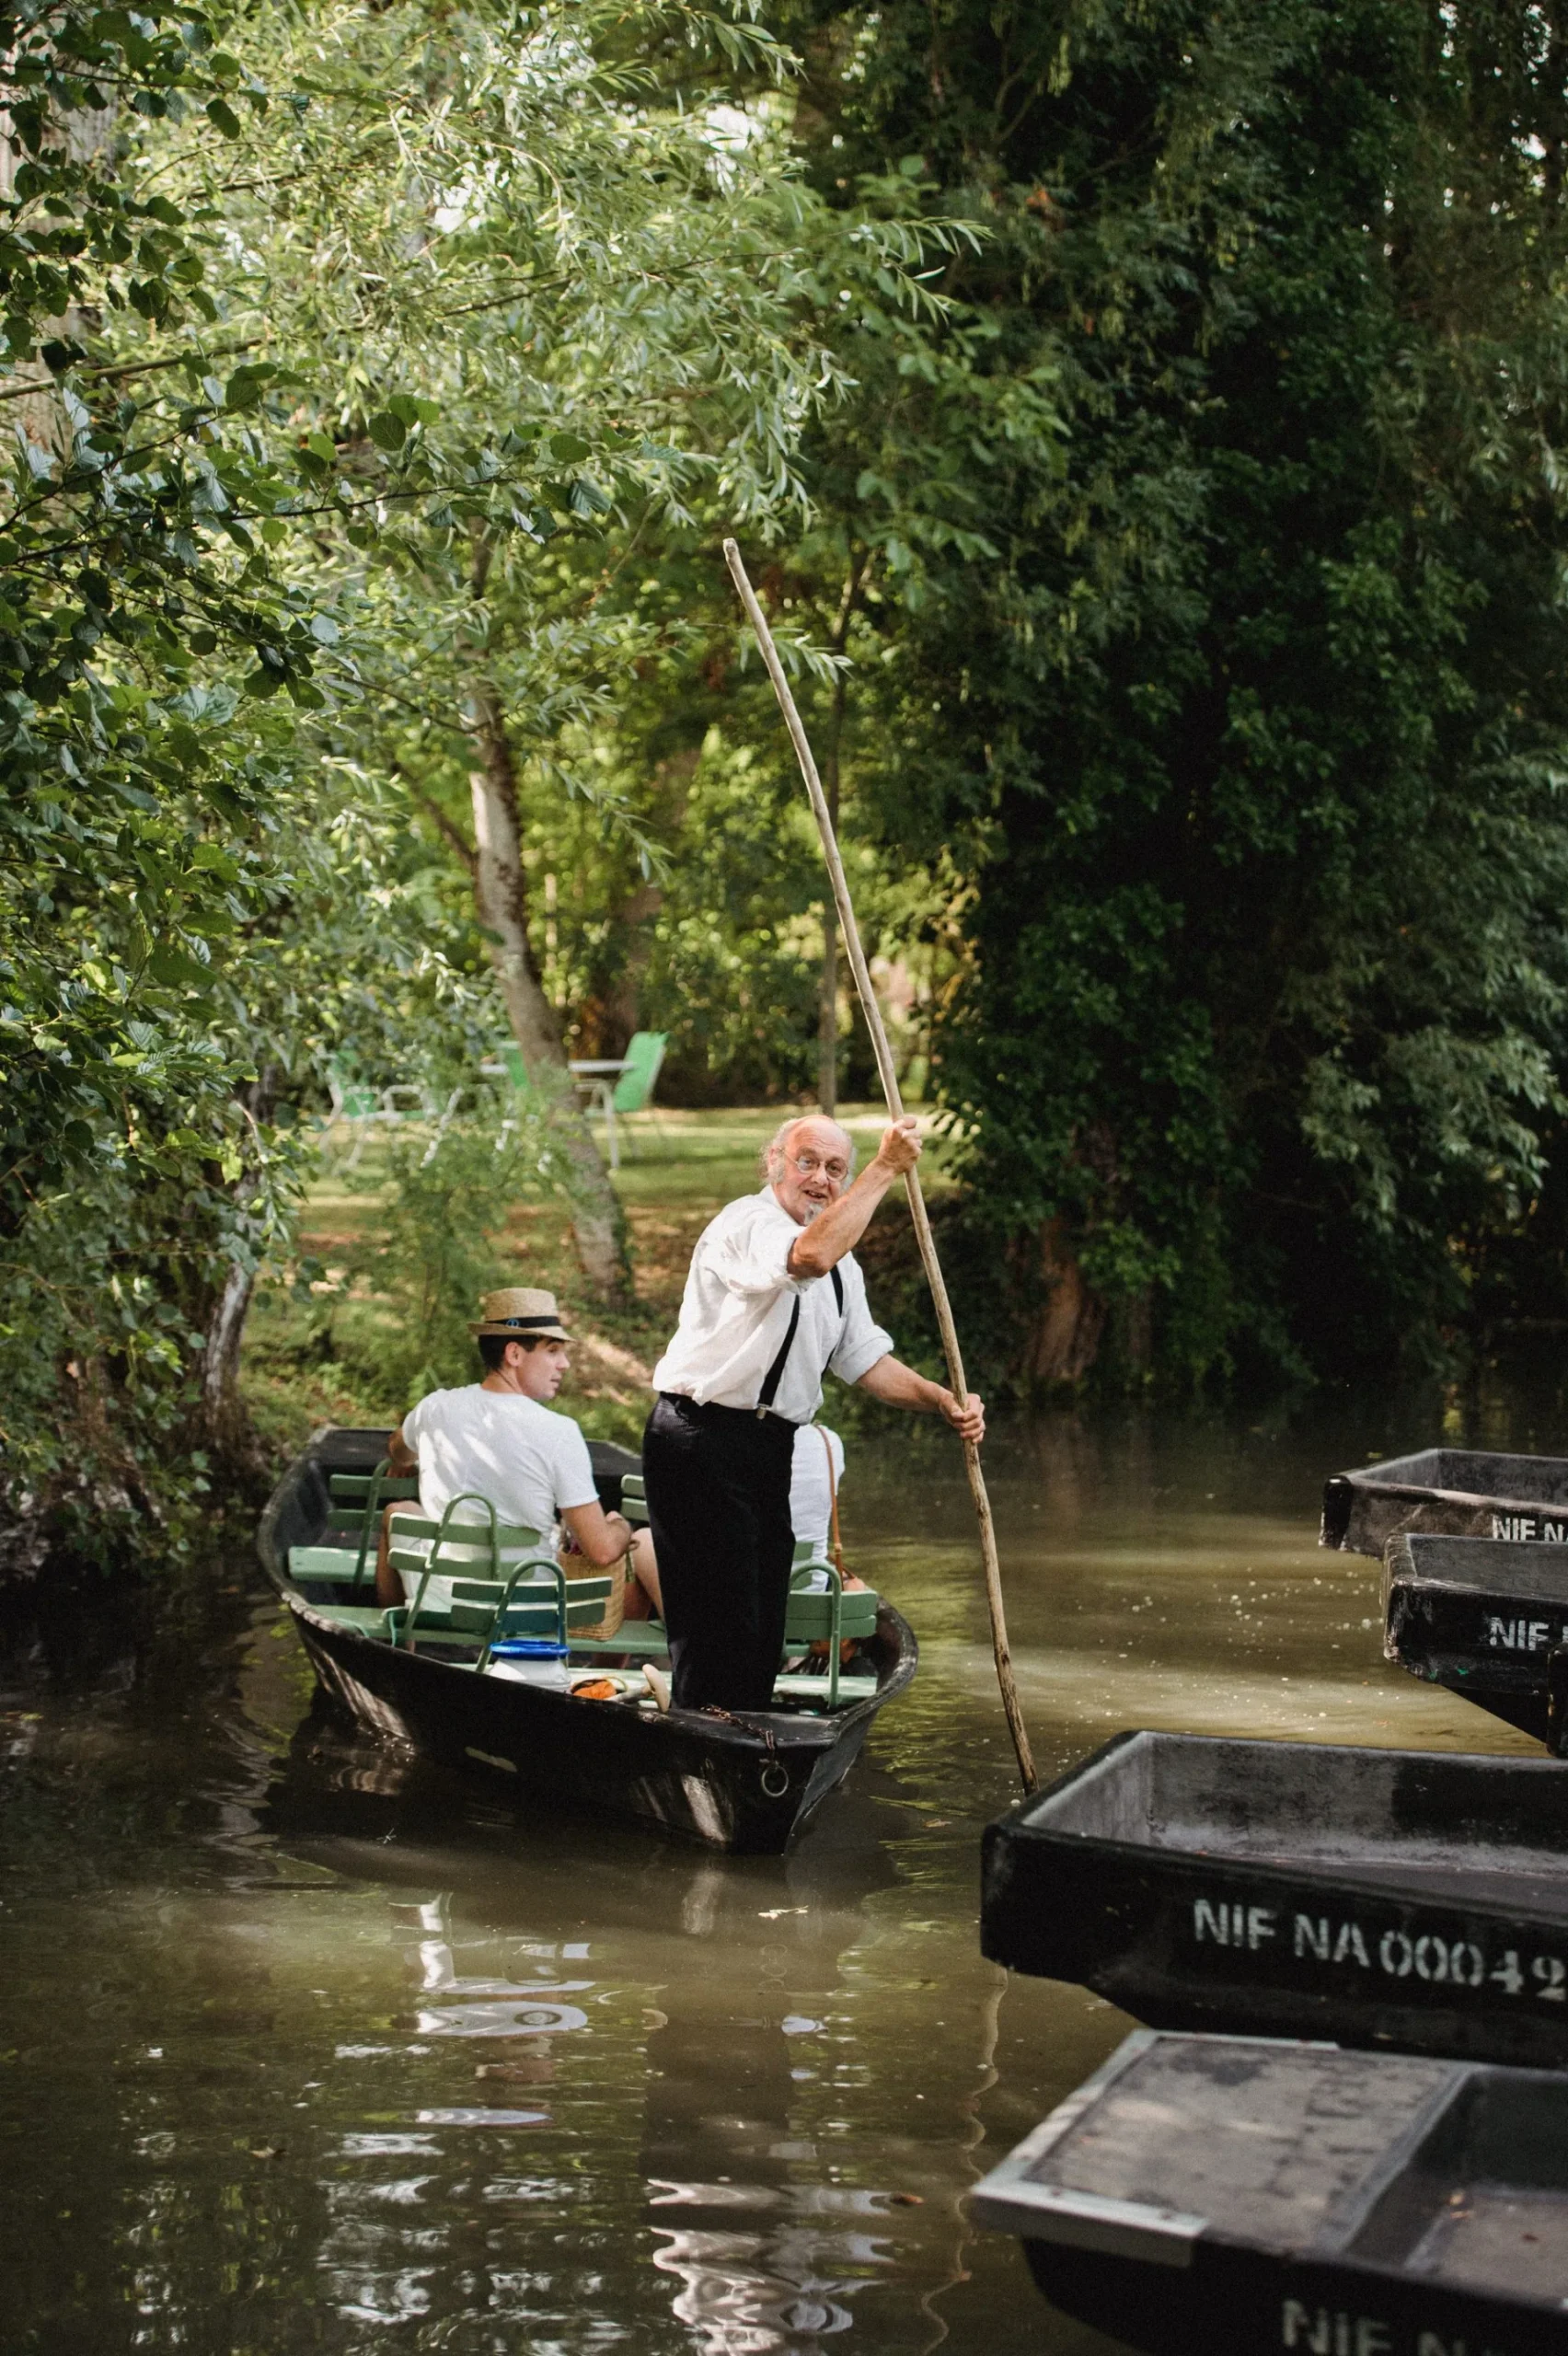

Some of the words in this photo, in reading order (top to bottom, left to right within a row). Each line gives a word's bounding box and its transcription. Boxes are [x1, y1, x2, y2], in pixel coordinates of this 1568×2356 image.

[1492, 1514, 1536, 1542] NIF
[1489, 1616, 1550, 1651] NIF
[1194, 1899, 1275, 1950] NIF
[1283, 2299, 1392, 2356] NIF
